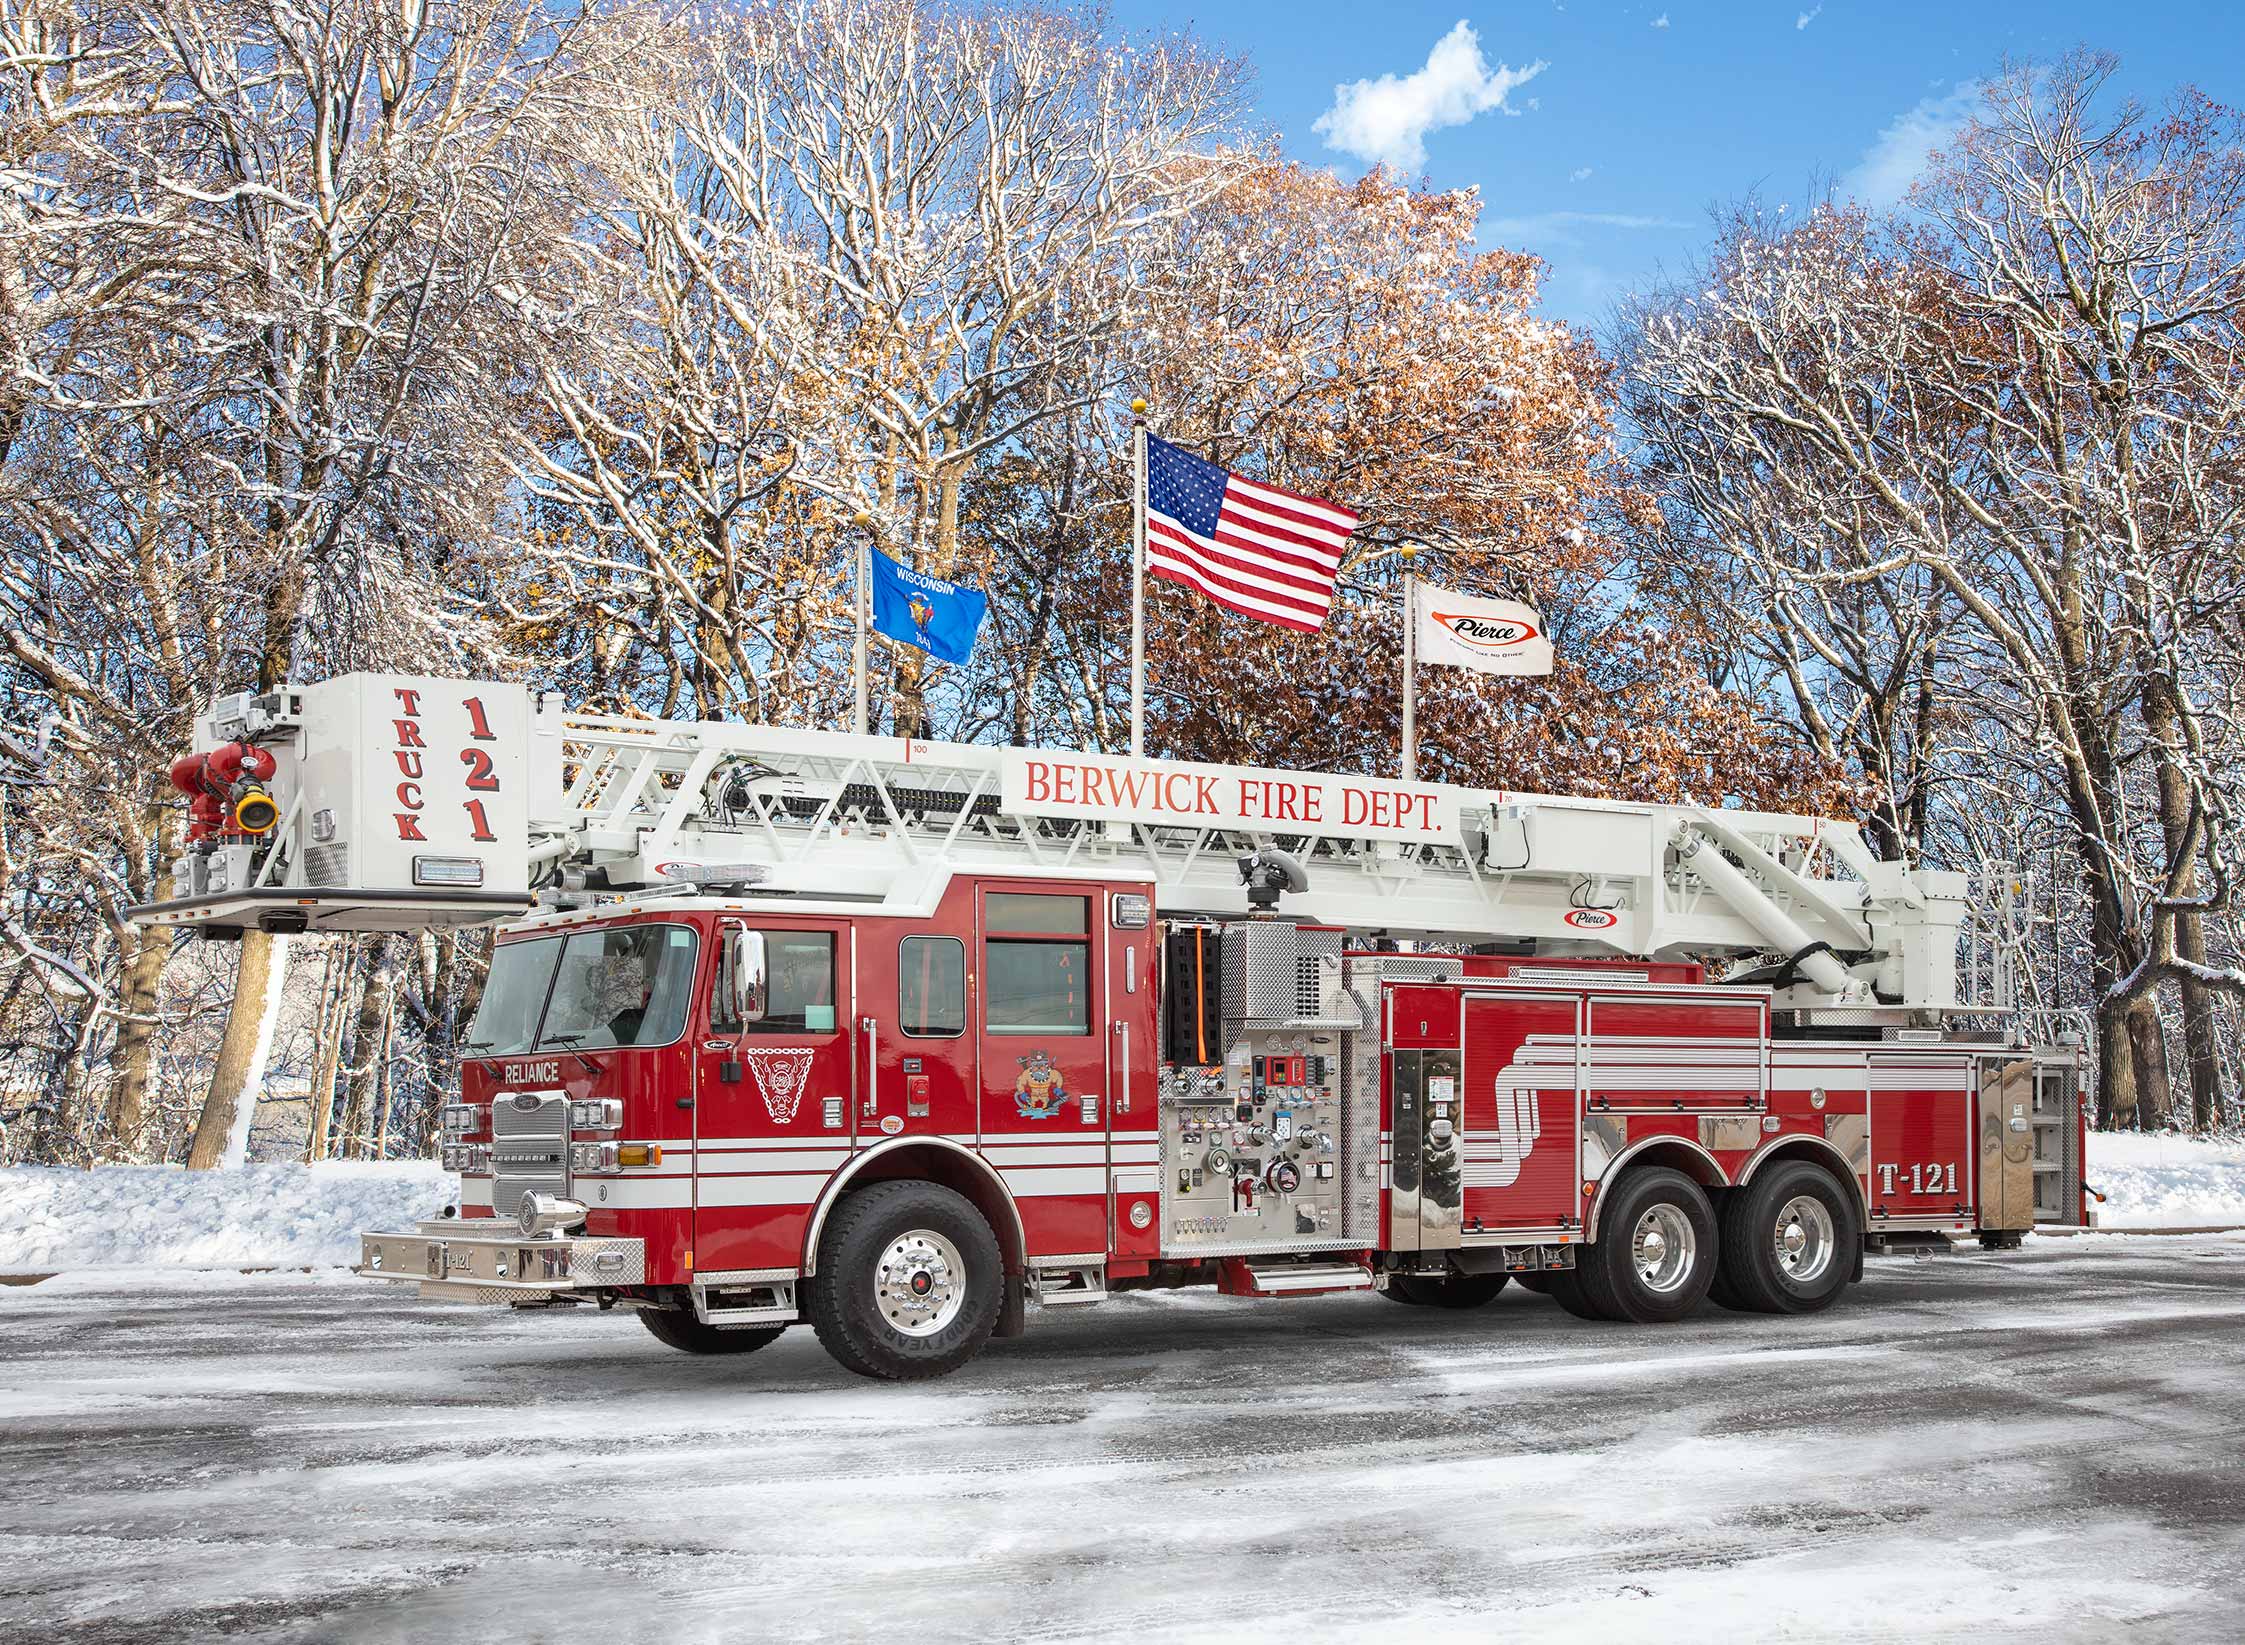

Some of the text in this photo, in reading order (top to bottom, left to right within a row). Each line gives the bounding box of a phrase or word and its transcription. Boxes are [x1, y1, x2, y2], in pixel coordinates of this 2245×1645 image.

[896, 566, 956, 596] WISCONSIN
[1454, 618, 1516, 640] Pierce
[913, 744, 928, 754] 100
[391, 688, 428, 842] TRUCK
[460, 696, 500, 843] 121
[1024, 761, 1442, 832] BERWICK FIRE DEPT.
[1575, 911, 1606, 925] Pierce
[505, 1061, 560, 1085] RELIANCE
[1877, 1162, 1959, 1196] T-121
